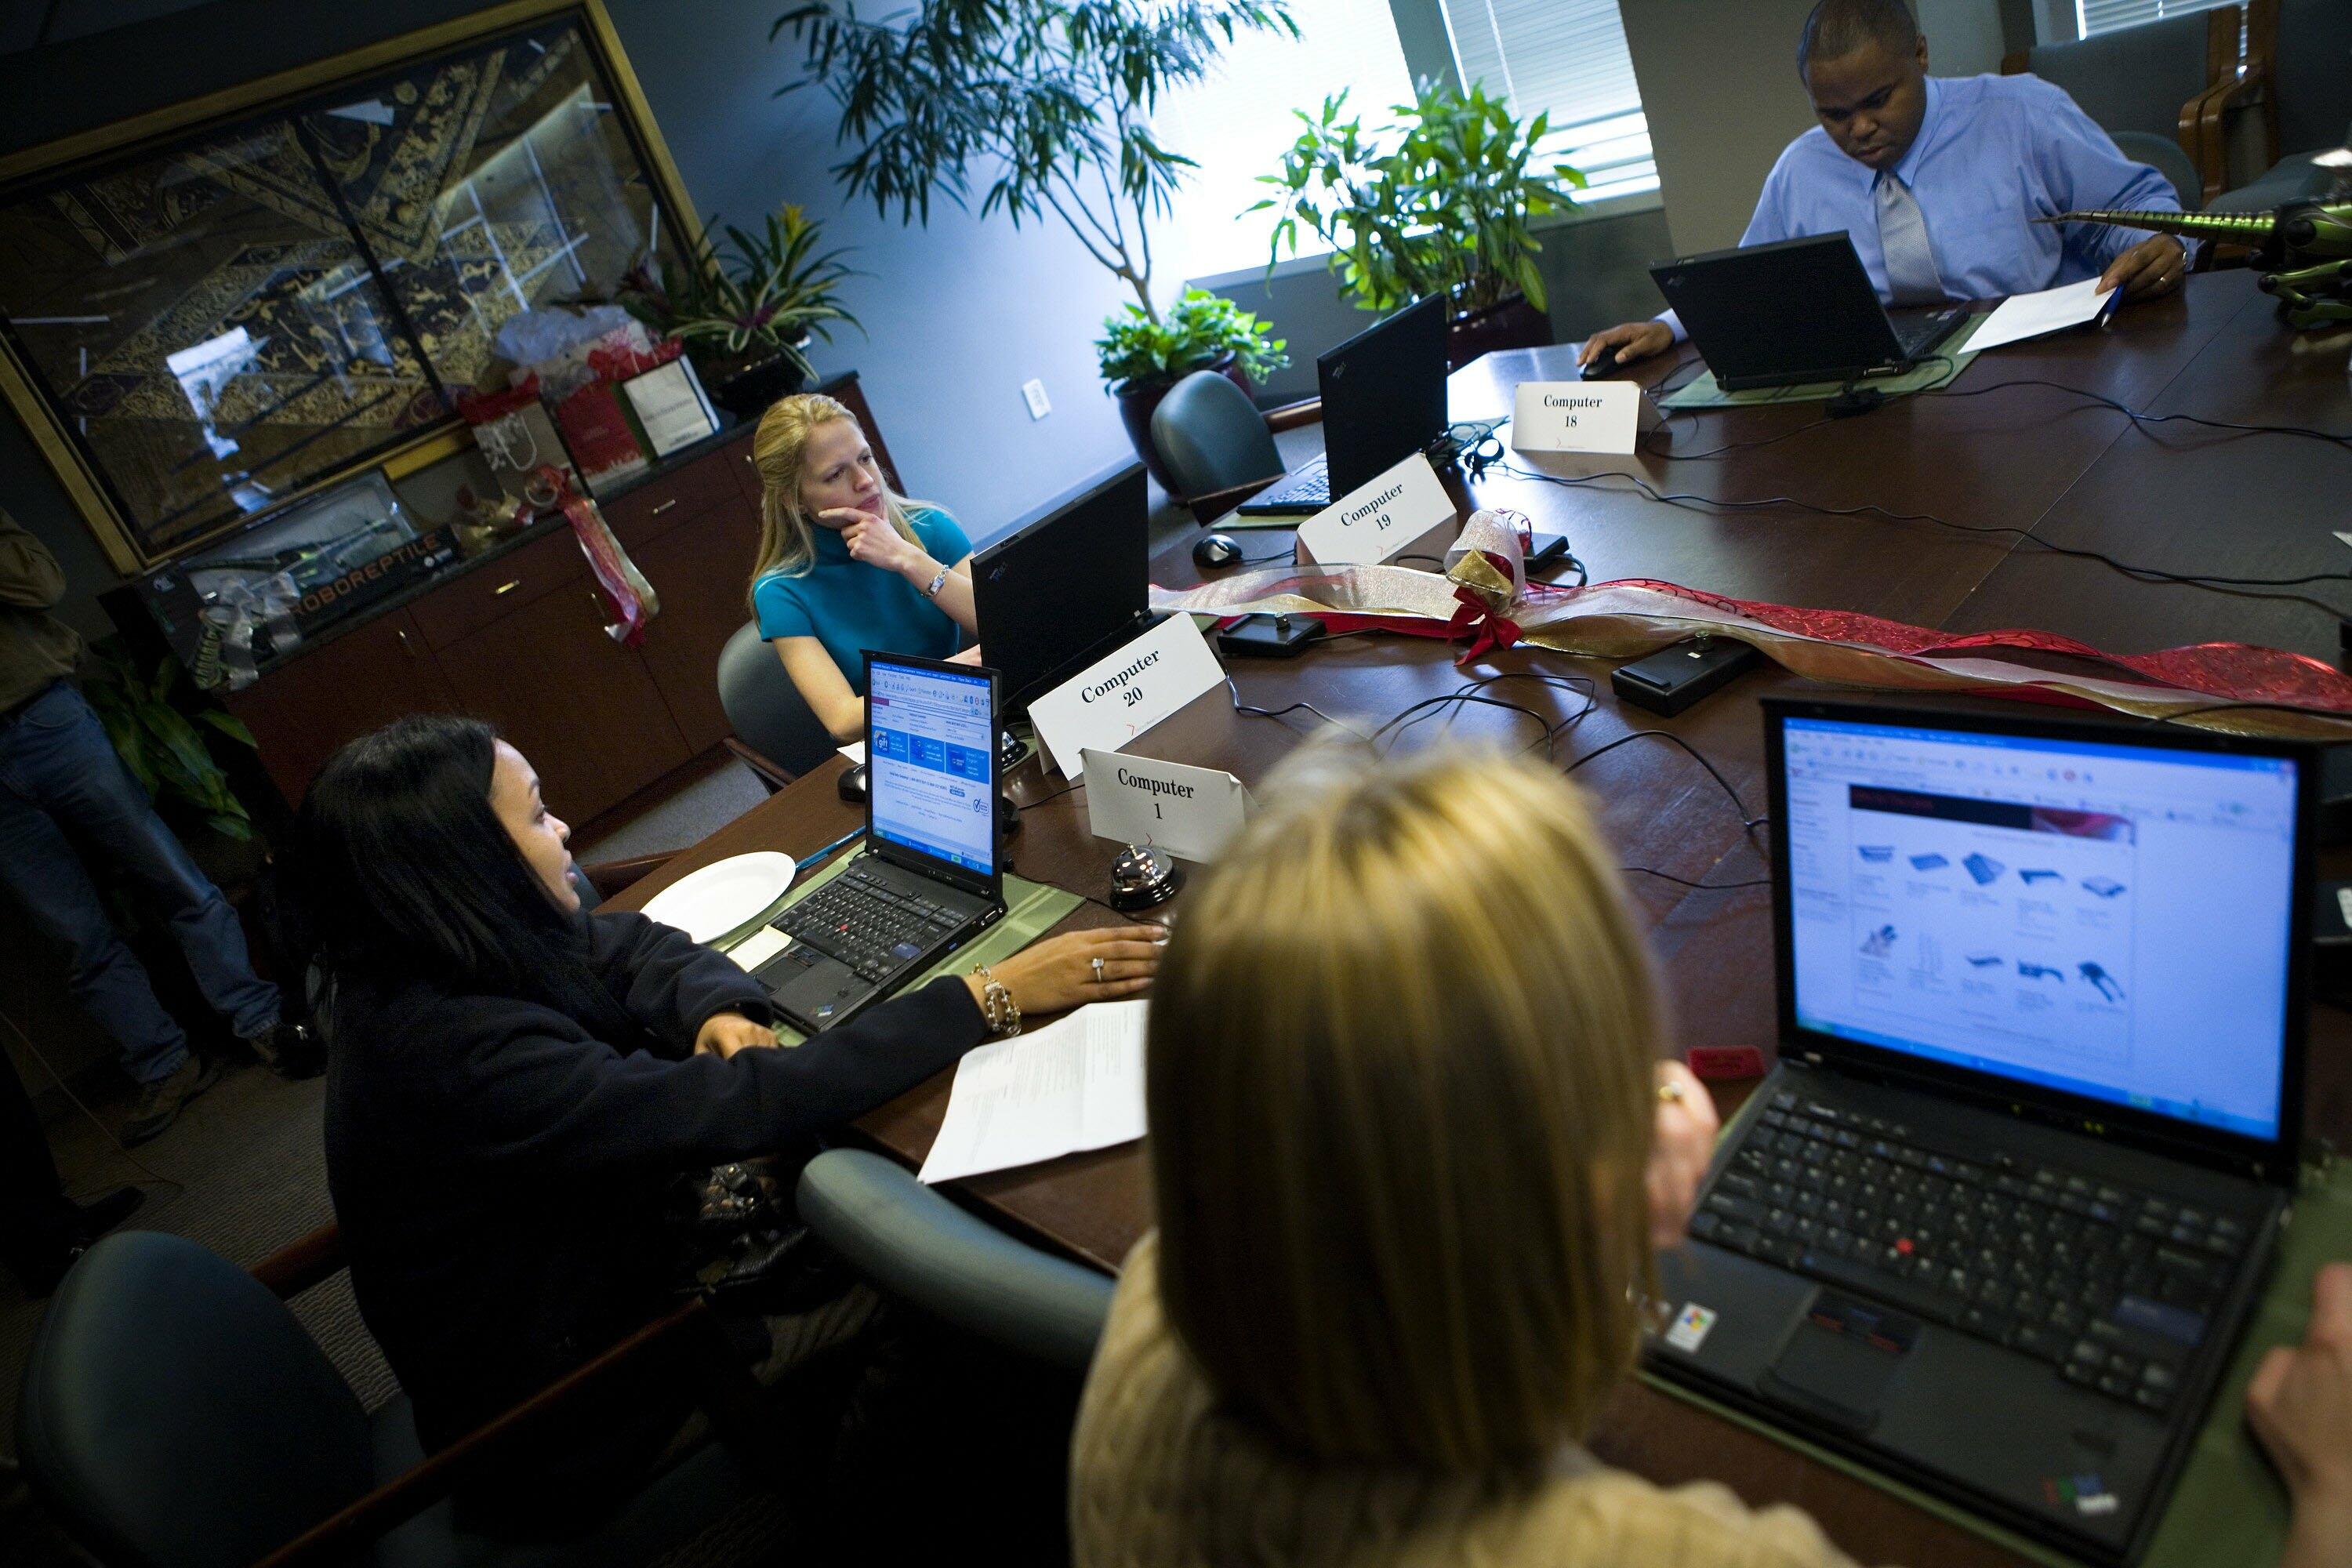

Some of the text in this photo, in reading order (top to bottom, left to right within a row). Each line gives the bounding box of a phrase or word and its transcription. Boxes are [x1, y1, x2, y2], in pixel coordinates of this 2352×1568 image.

[1544, 394, 1602, 410] Computer
[1565, 416, 1577, 427] 18
[1341, 483, 1403, 527] Computer
[1375, 514, 1391, 531] 19
[1081, 649, 1160, 703] Computer
[1123, 687, 1143, 707] 20
[1118, 768, 1194, 798] Computer
[1154, 803, 1163, 819] 1
